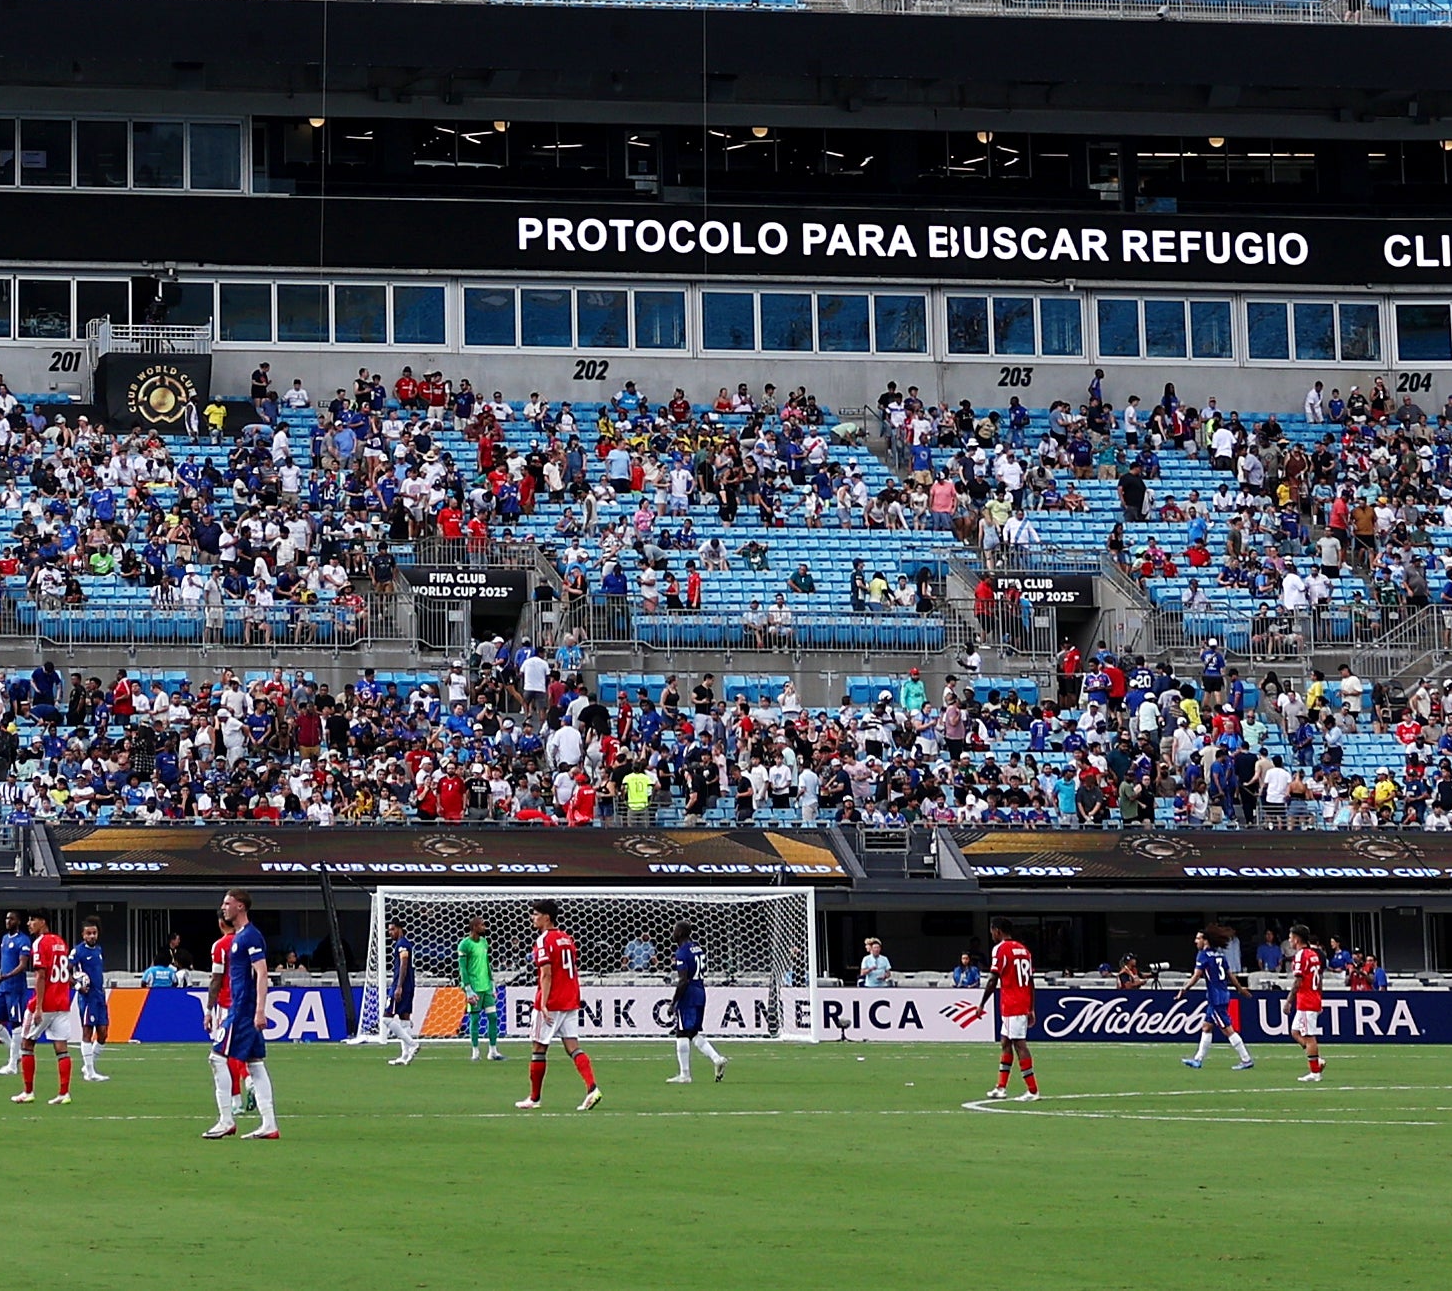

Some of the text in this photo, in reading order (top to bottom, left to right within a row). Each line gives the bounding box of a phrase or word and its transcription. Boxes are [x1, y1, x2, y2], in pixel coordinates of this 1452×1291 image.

[519, 218, 1308, 265] PROTOCOLO PARA BUSCAR REFUGIO
[48, 350, 81, 372] 201
[573, 358, 609, 380] 202
[127, 381, 139, 414] CLUB
[136, 365, 178, 383] WORLD
[998, 367, 1033, 387] 203
[1397, 371, 1432, 392] 204
[261, 863, 305, 874] FIFA
[310, 863, 366, 874] CLUB
[369, 863, 447, 874] WORLD
[451, 863, 492, 874] CUP
[50, 955, 69, 983] 68
[561, 948, 574, 979] 4
[1216, 957, 1225, 981] 3
[186, 990, 330, 1039] VSA
[515, 999, 635, 1029] BNK
[720, 1000, 924, 1030] AMERICA
[1043, 996, 1422, 1037] Michelob UTRA
